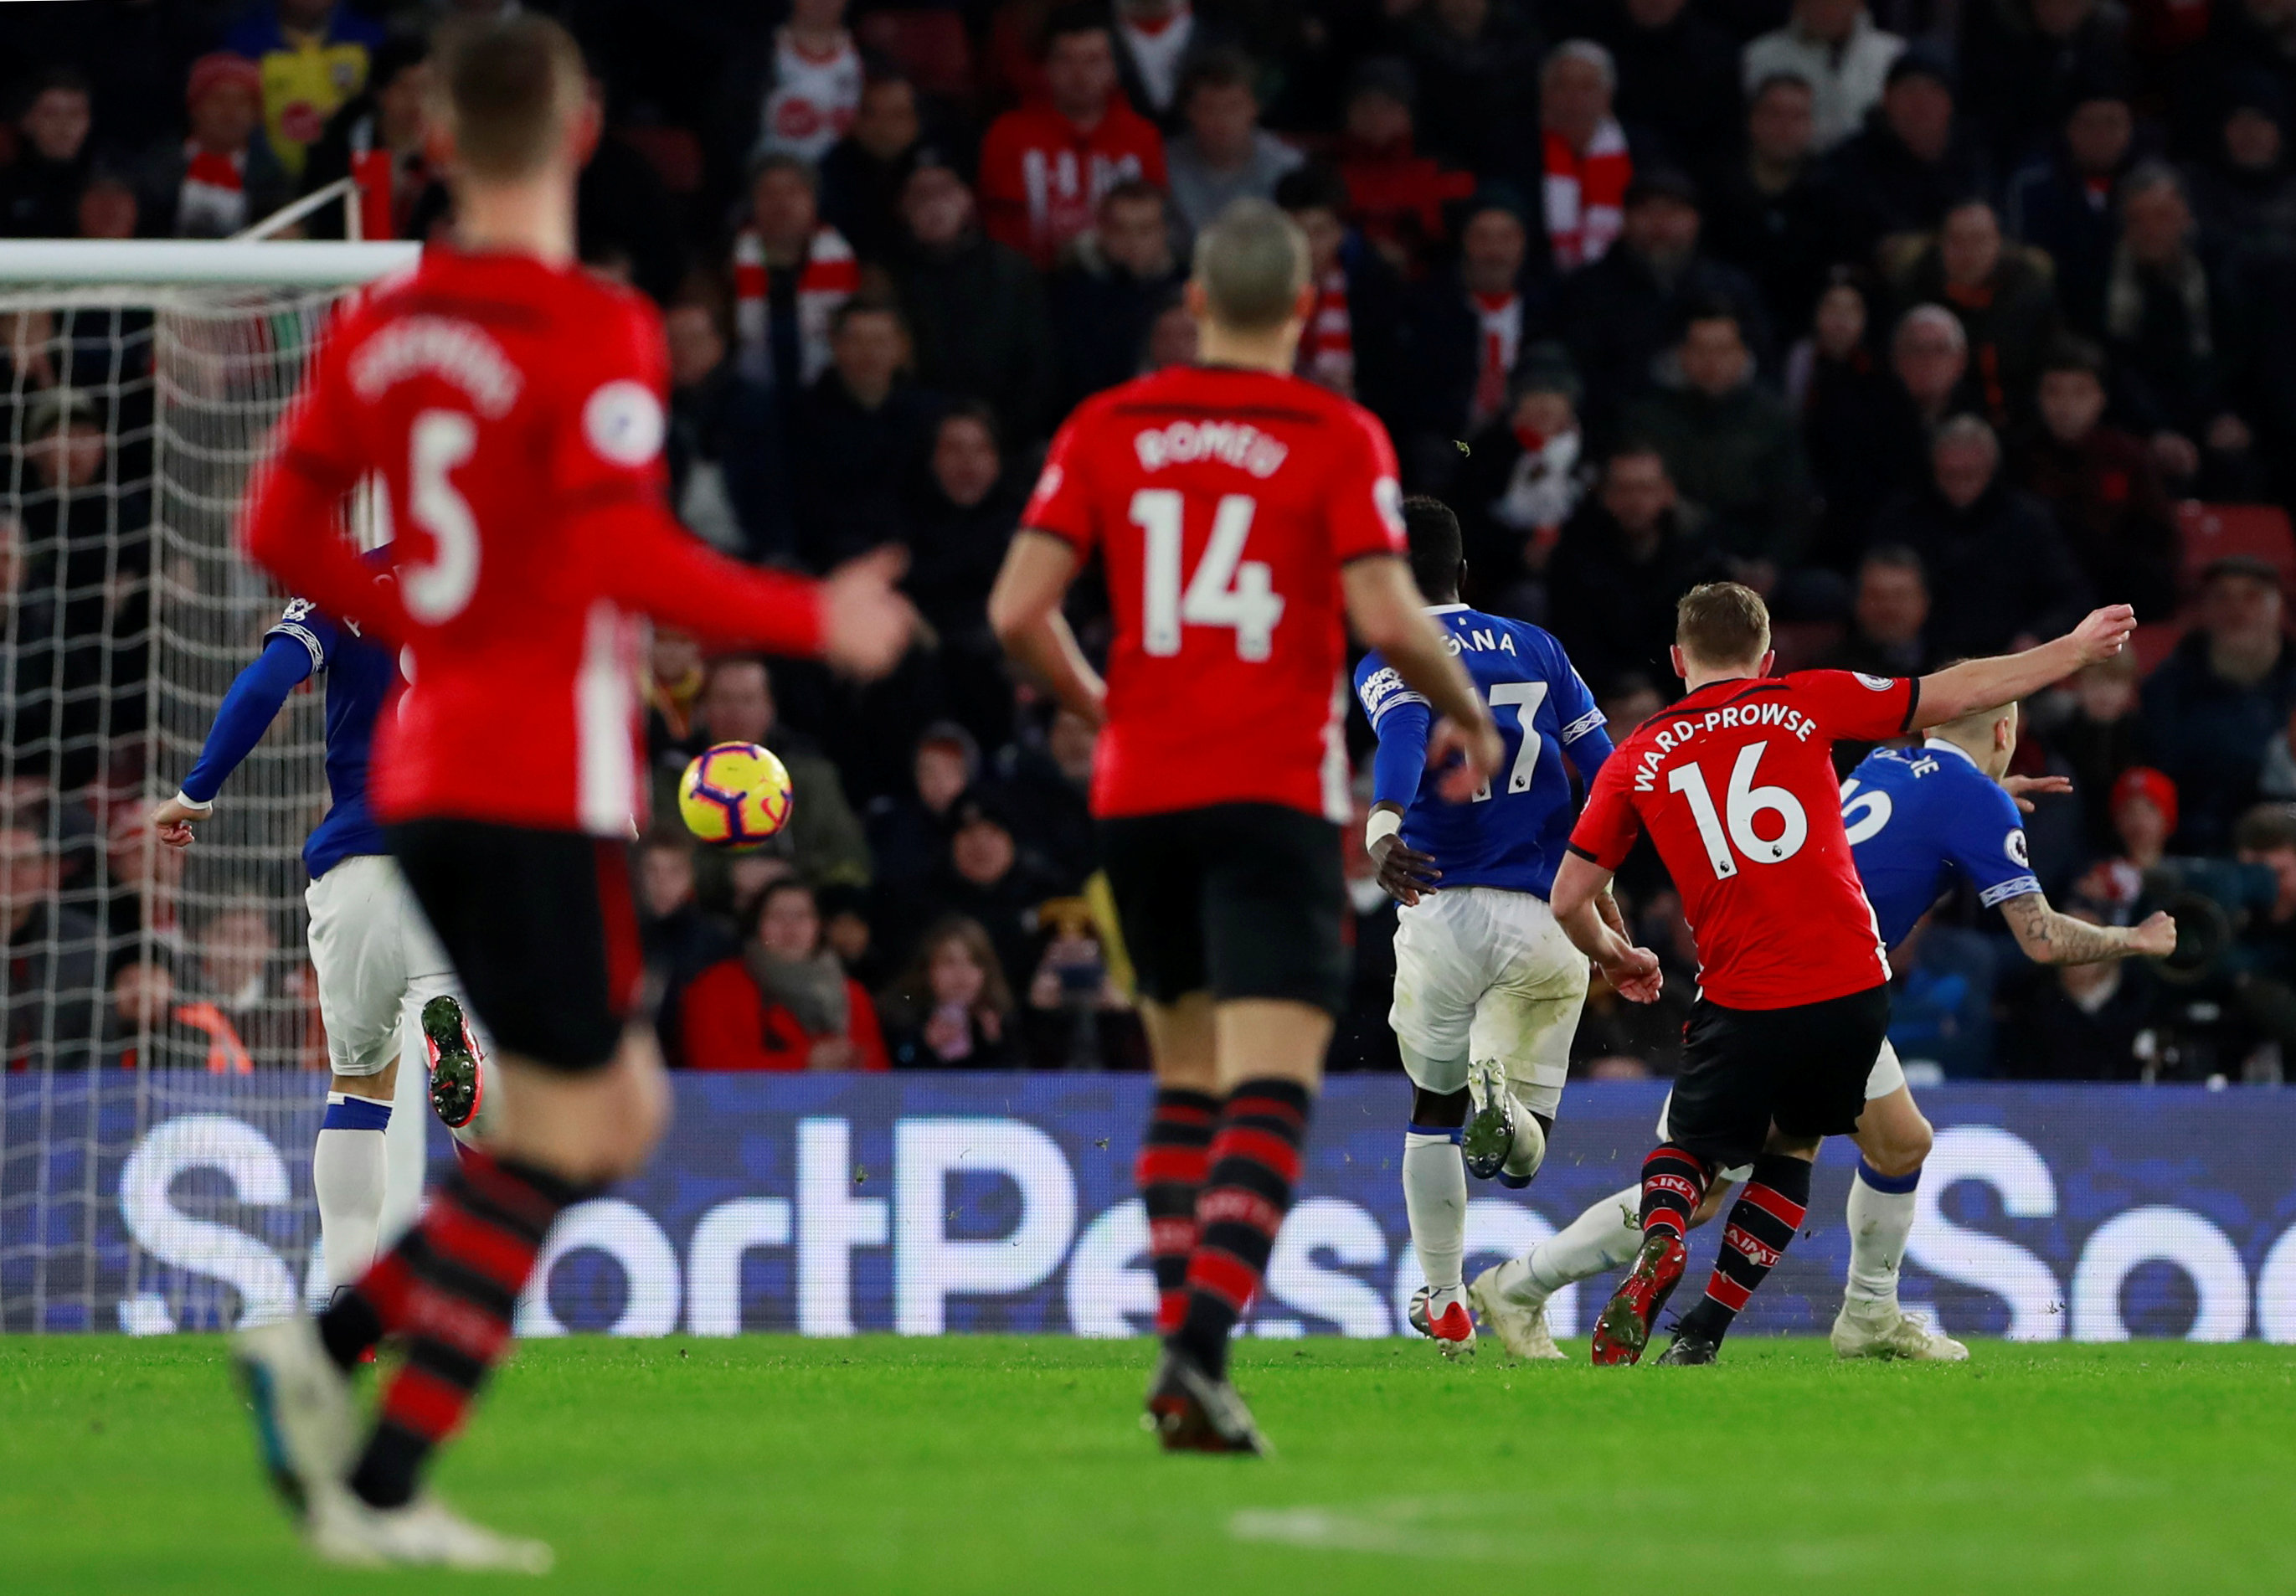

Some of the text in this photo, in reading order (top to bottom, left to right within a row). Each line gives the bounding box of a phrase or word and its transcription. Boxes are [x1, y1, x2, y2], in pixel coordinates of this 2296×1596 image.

[407, 407, 484, 626] 5
[1134, 419, 1289, 478] ROMEU
[1128, 487, 1286, 663] 14
[1634, 703, 1817, 792] WARD-PROWSE
[1668, 739, 1808, 880] 16
[1901, 1124, 2296, 1343] So
